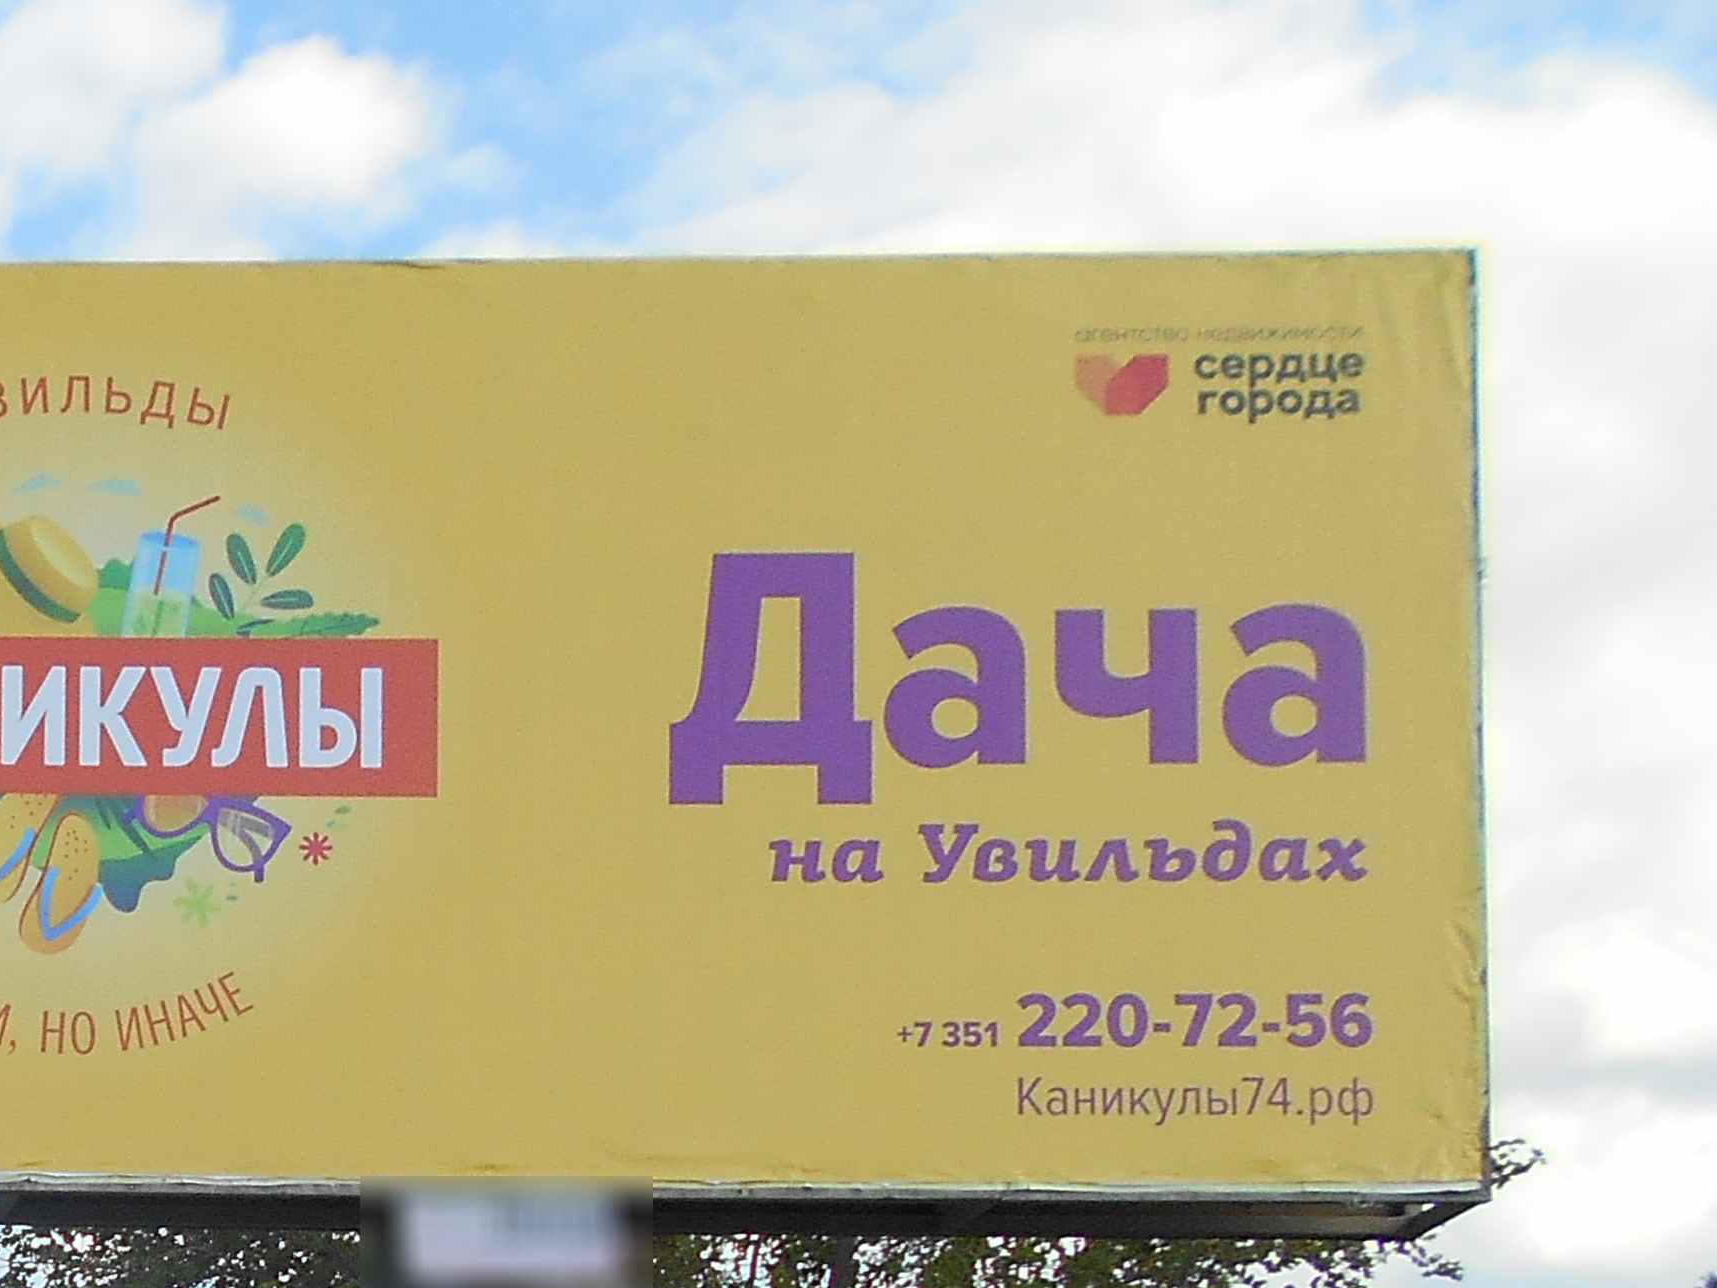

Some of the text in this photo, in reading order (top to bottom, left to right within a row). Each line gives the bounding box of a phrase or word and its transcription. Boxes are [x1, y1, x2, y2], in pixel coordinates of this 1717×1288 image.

[1194, 352, 1366, 388] сердце
[1196, 388, 1362, 424] города
[669, 551, 1371, 808] Дача
[769, 819, 1370, 886] на Увильдах
[40, 1010, 98, 1057] НО
[115, 971, 255, 1053] ИНАЧЕ
[896, 993, 1376, 1050] +7 351 220-72-56
[1018, 1076, 1376, 1127] Каникулы74.рф
